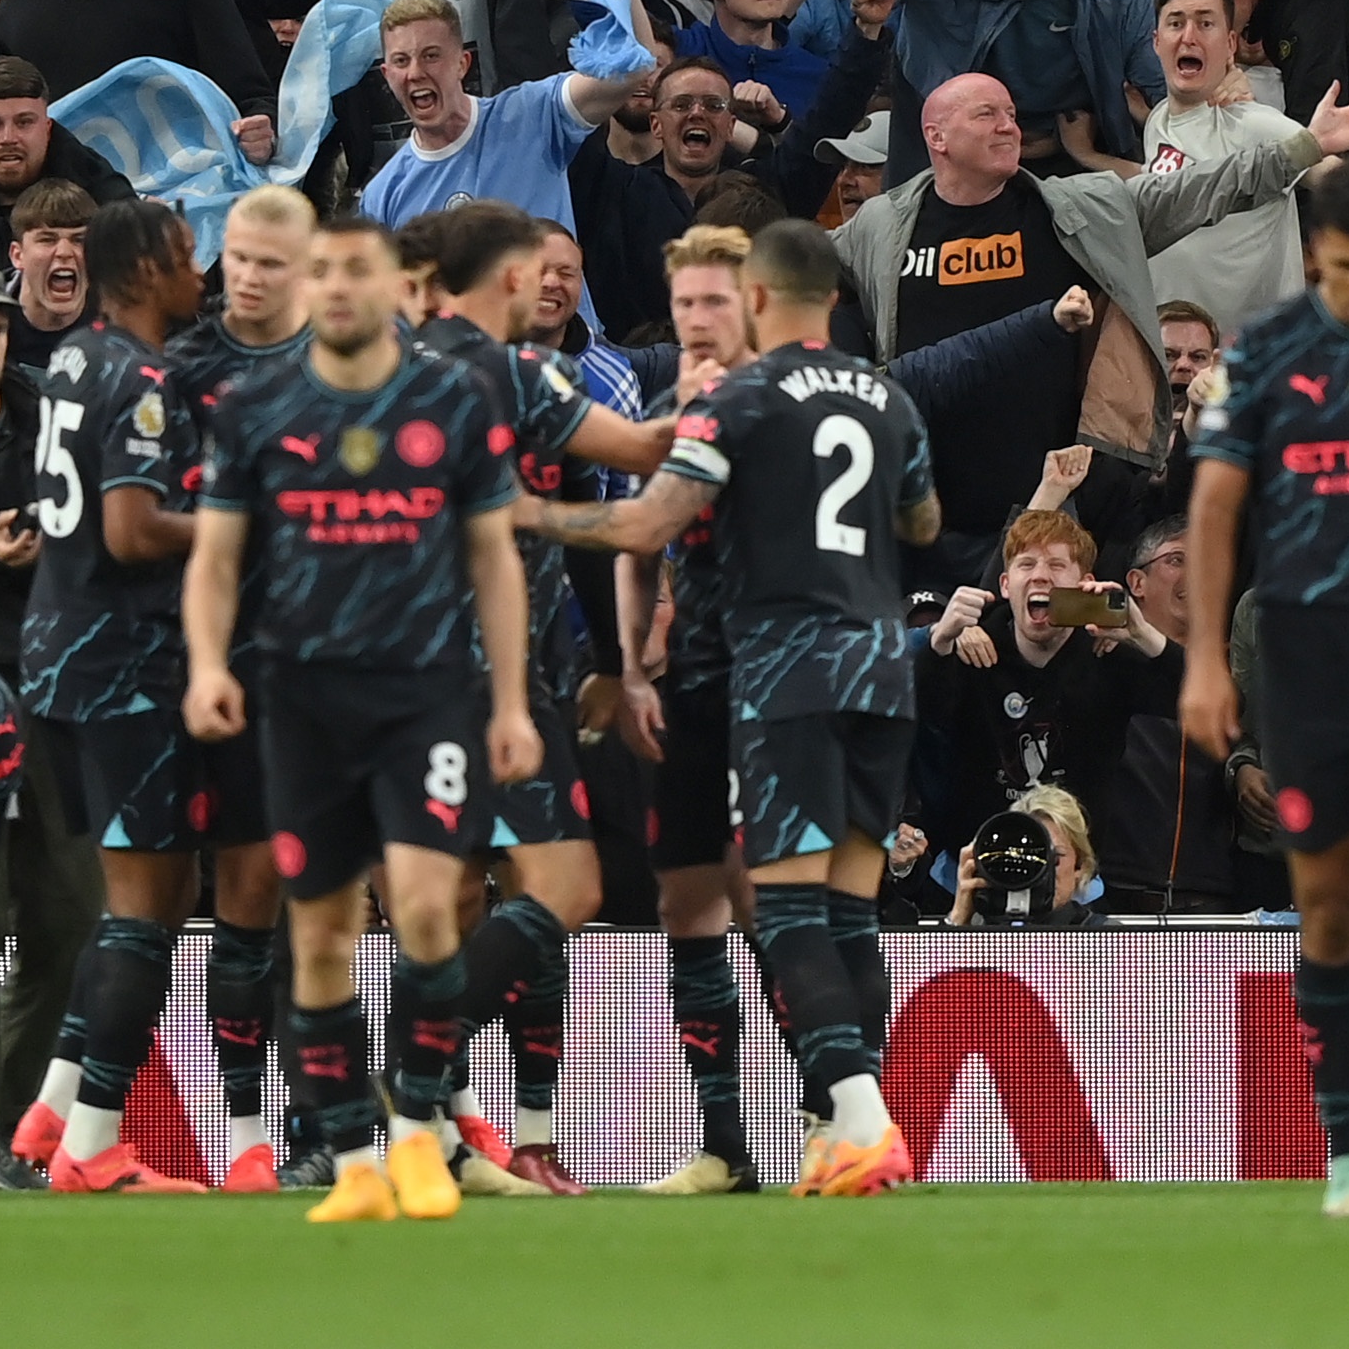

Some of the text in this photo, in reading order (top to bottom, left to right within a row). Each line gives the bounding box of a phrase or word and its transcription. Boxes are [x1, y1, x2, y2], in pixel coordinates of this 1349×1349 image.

[943, 243, 1017, 277] club
[778, 366, 889, 412] WALKER
[275, 487, 446, 523] ETIHAD
[812, 413, 875, 557] 2
[423, 741, 468, 806] 8
